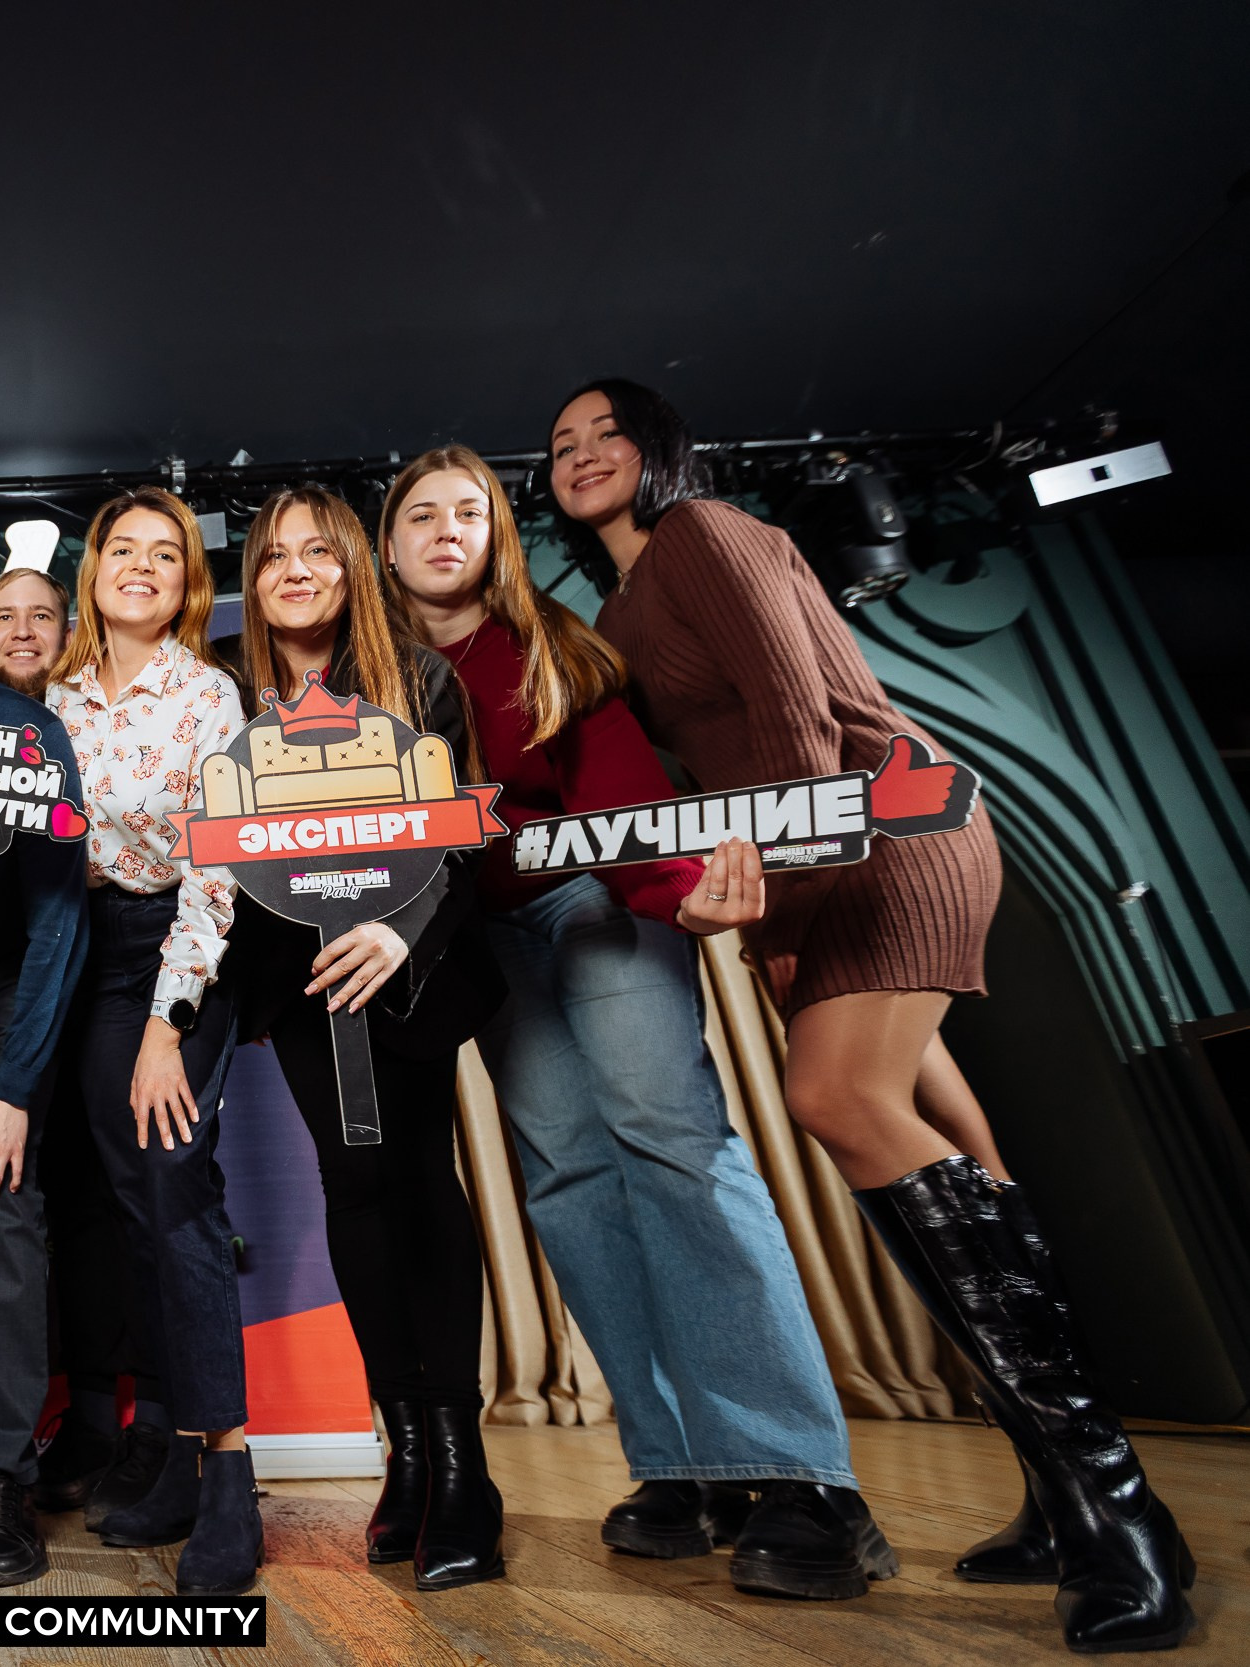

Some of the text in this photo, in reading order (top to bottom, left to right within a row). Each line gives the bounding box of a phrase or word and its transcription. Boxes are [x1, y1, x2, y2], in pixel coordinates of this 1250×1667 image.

[238, 810, 430, 853] ЭКСПЕРТ
[515, 778, 866, 871] #ЛУЧШИЕ
[762, 841, 842, 860] ЭЙНШТЕЙН
[289, 868, 390, 892] ЭЙНШТЕЙН
[321, 884, 362, 899] Party
